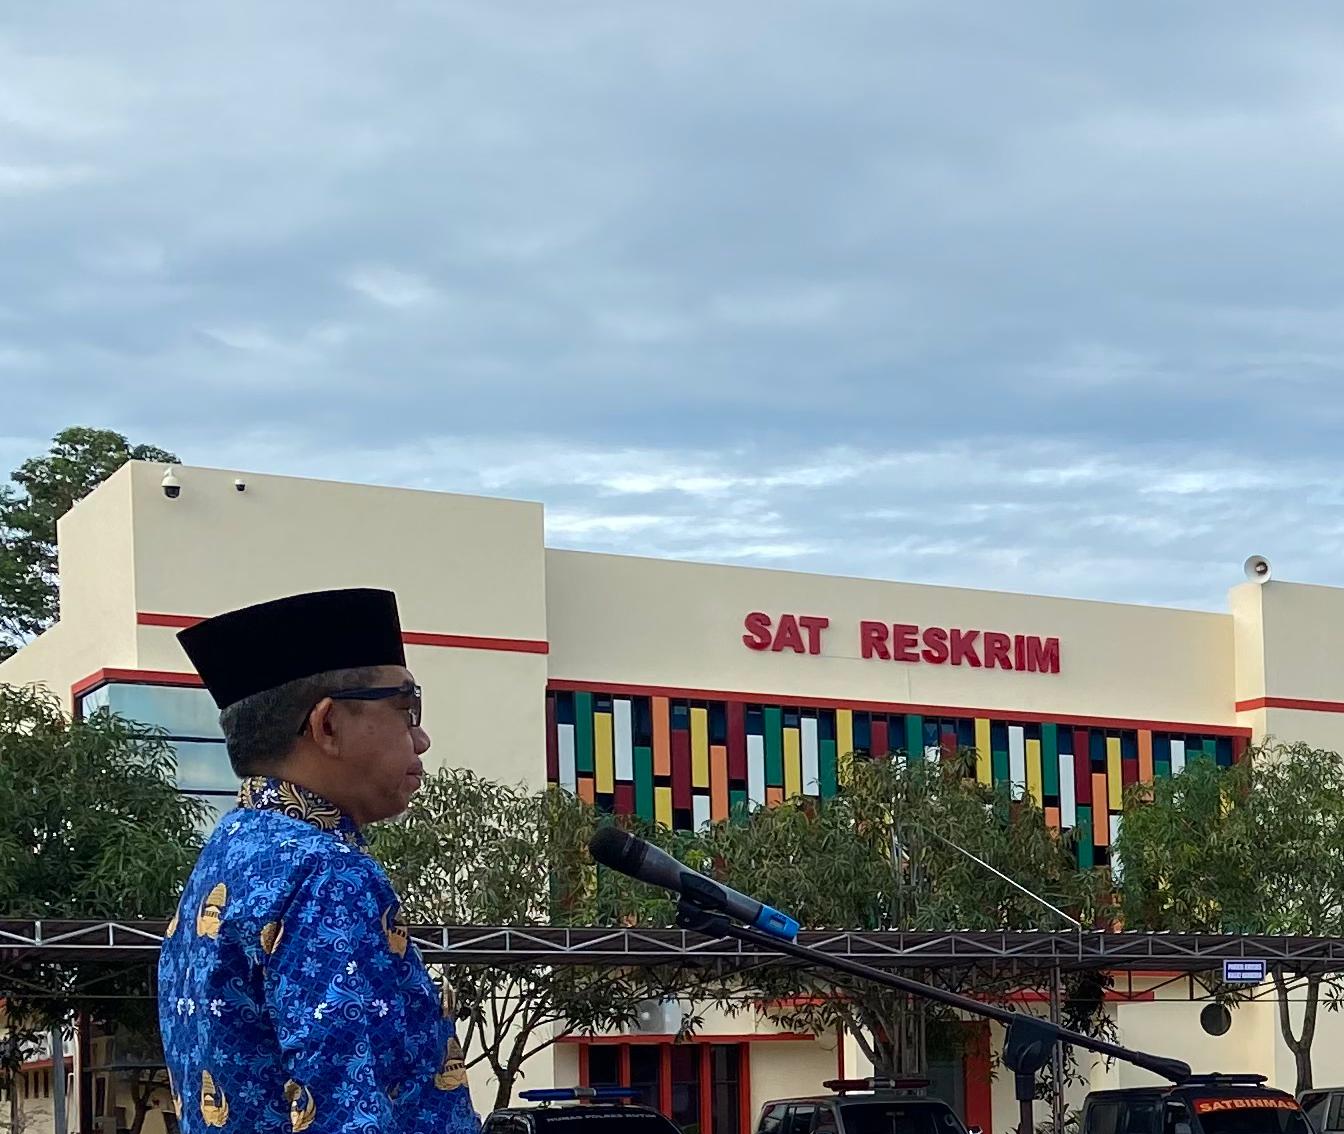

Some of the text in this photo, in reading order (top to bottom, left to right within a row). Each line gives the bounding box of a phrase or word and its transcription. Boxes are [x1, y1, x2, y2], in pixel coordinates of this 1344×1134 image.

[742, 611, 1060, 674] SAT RESKRIM
[1199, 1099, 1298, 1112] SATBINMAS
